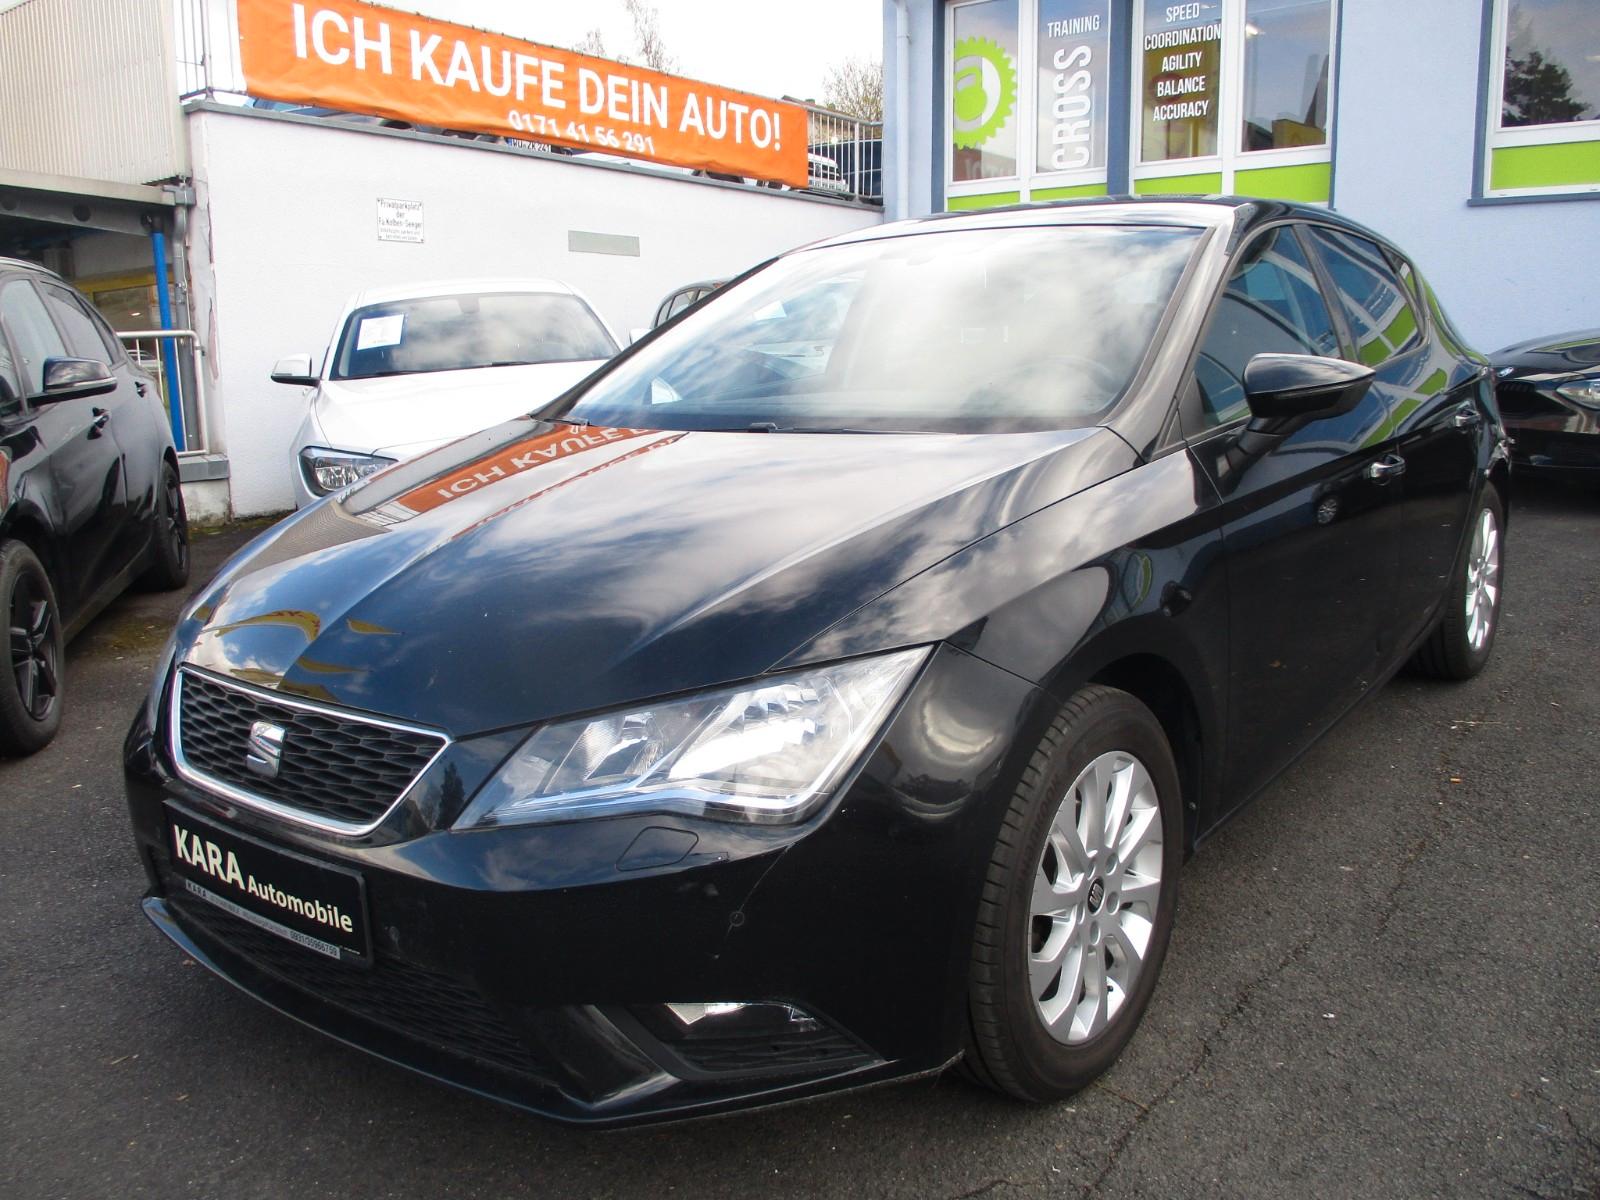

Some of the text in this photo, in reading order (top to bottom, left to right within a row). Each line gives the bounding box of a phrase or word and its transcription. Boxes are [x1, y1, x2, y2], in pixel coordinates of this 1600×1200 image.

[1166, 2, 1200, 22] SPEED
[1047, 14, 1100, 38] TRAINING
[1144, 23, 1221, 51] COORDINATION
[1161, 52, 1202, 73] AGILITY
[292, 3, 781, 151] ICH KAUFE DEIN AUTO!
[1157, 76, 1206, 98] BALANCE
[1052, 45, 1092, 170] CROSS
[1153, 100, 1209, 122] ACCURACY
[508, 109, 656, 156] 0171 41 56 291
[174, 824, 246, 890] KARA
[248, 875, 353, 933] Automobile
